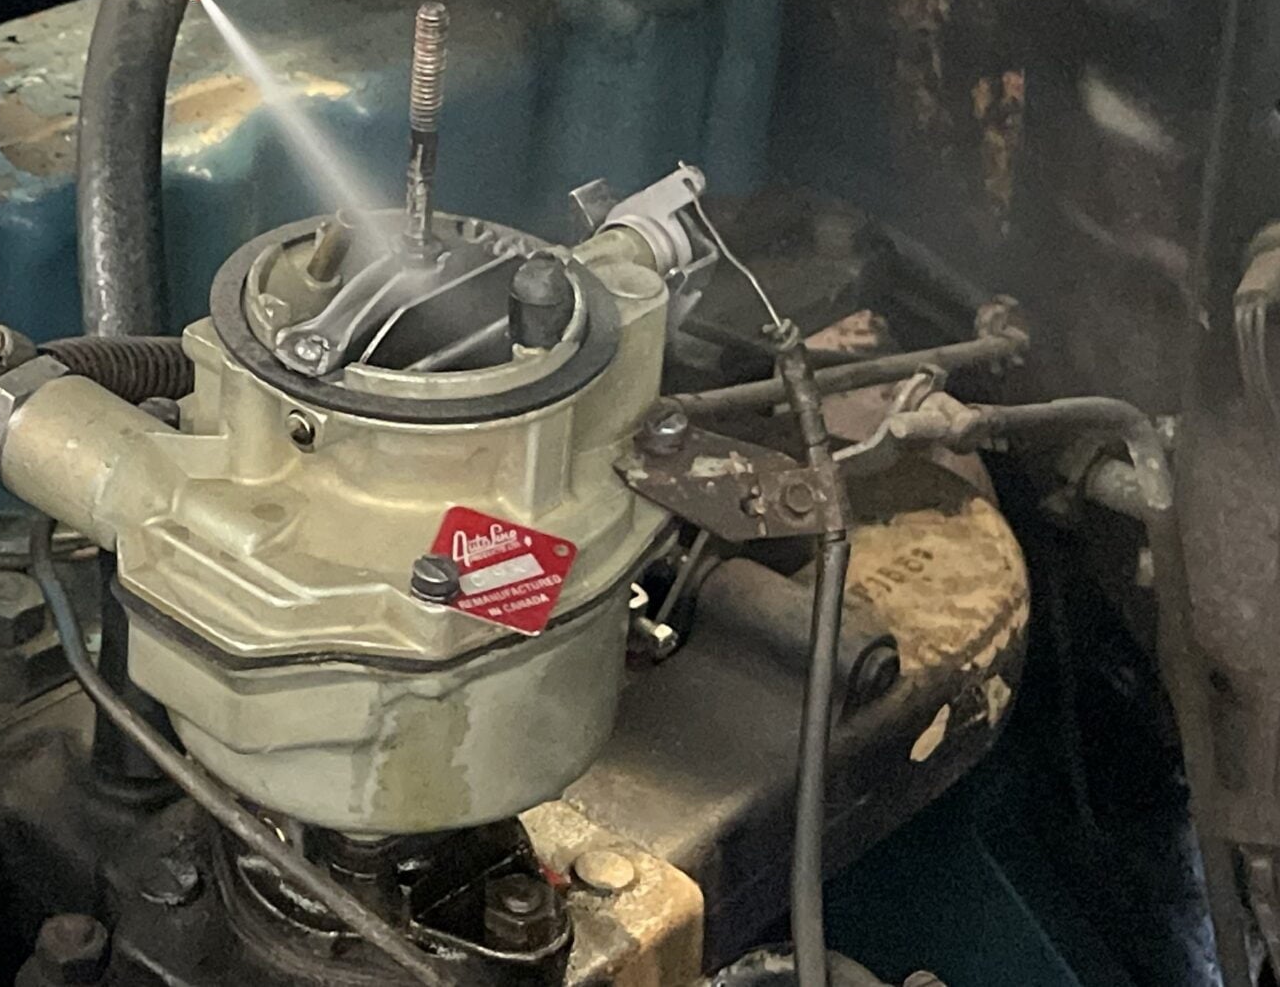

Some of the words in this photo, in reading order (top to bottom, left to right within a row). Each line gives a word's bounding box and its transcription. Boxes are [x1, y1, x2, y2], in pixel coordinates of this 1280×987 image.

[457, 574, 562, 609] REMANUFACTURED
[488, 606, 503, 617] IN
[503, 593, 550, 614] CANADA
